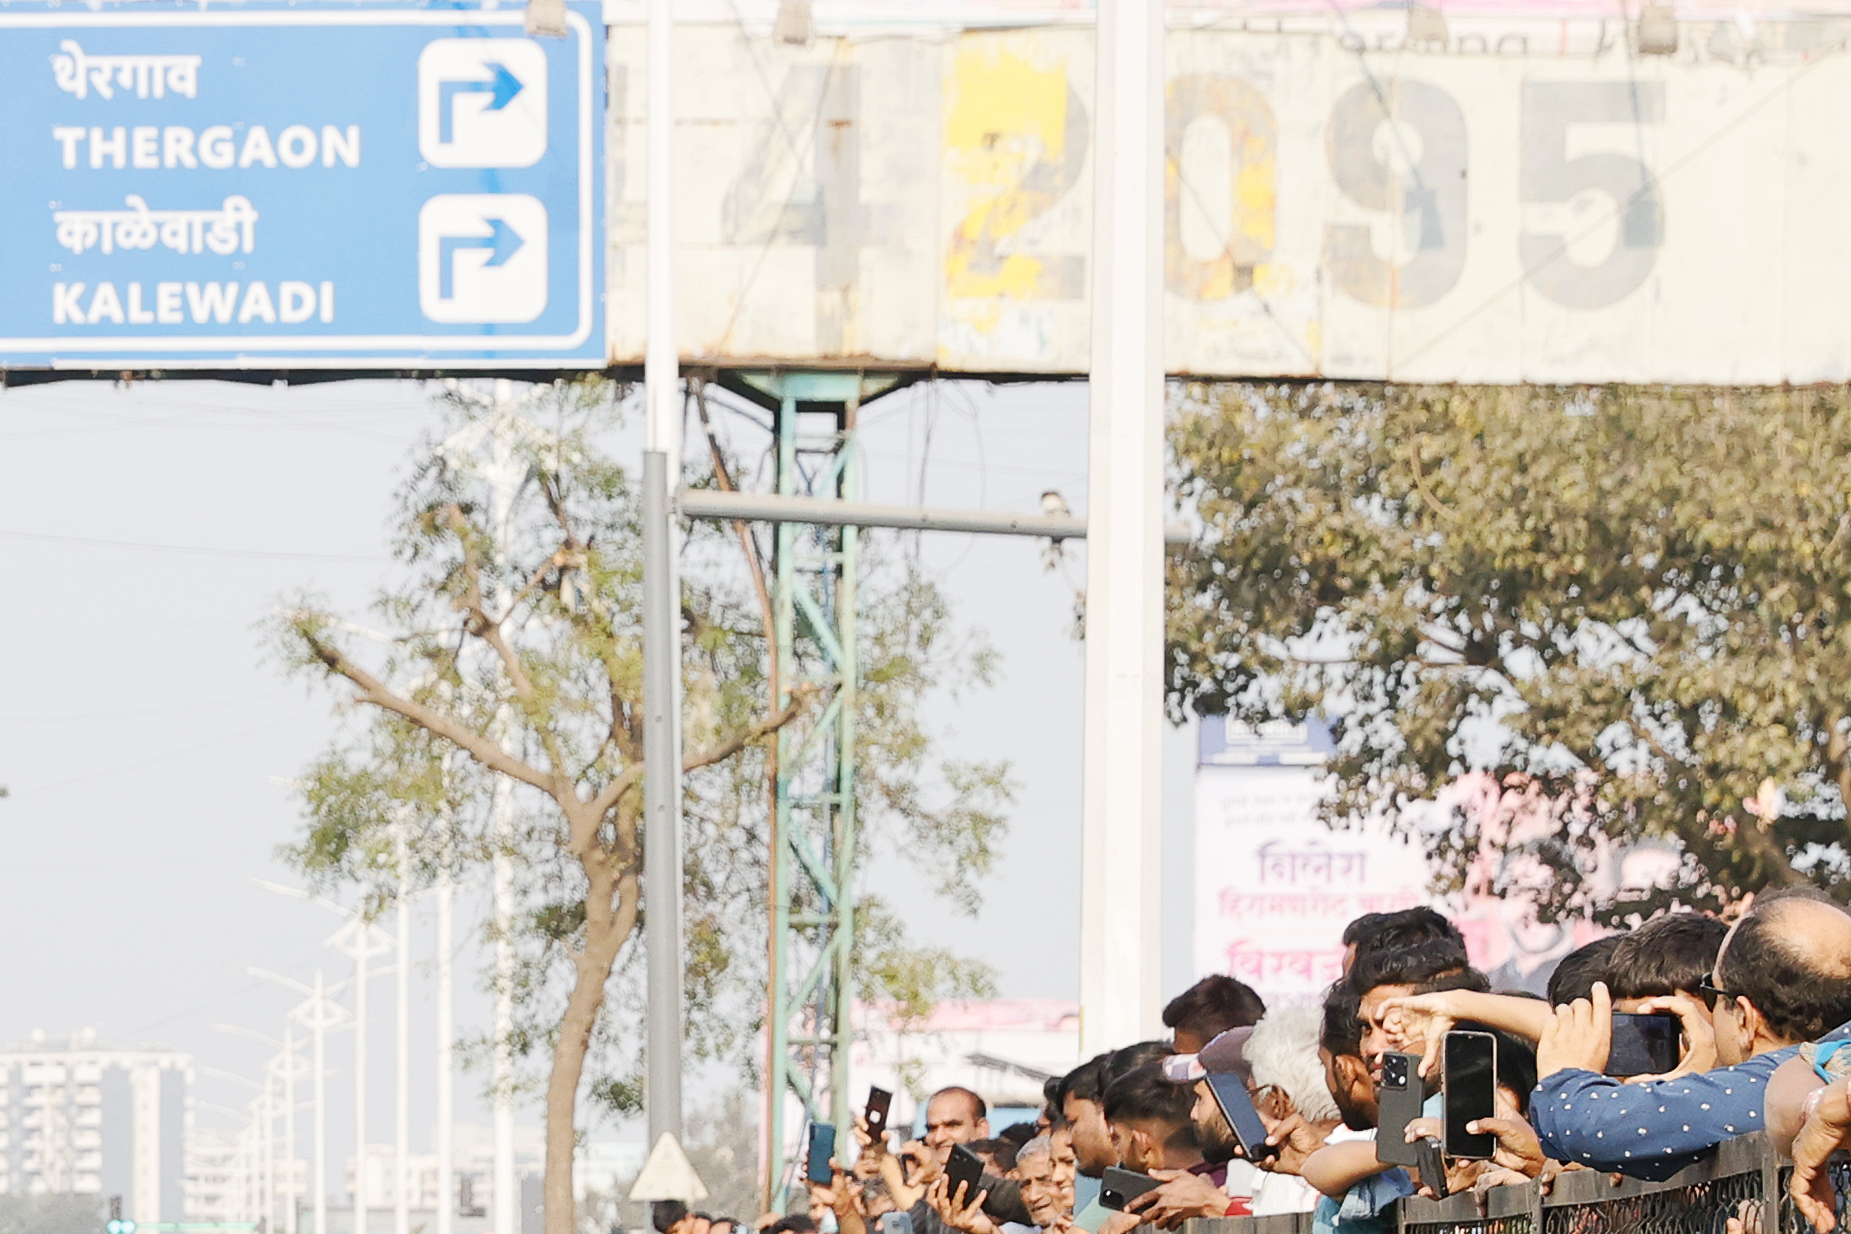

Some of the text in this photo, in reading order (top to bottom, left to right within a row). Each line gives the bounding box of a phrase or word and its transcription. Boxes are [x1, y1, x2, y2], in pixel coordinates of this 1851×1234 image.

[53, 40, 202, 100] थेरगाव
[53, 125, 362, 169] THERGAON
[54, 194, 259, 256] काळेवाडी
[53, 280, 334, 324] KALEWADI
